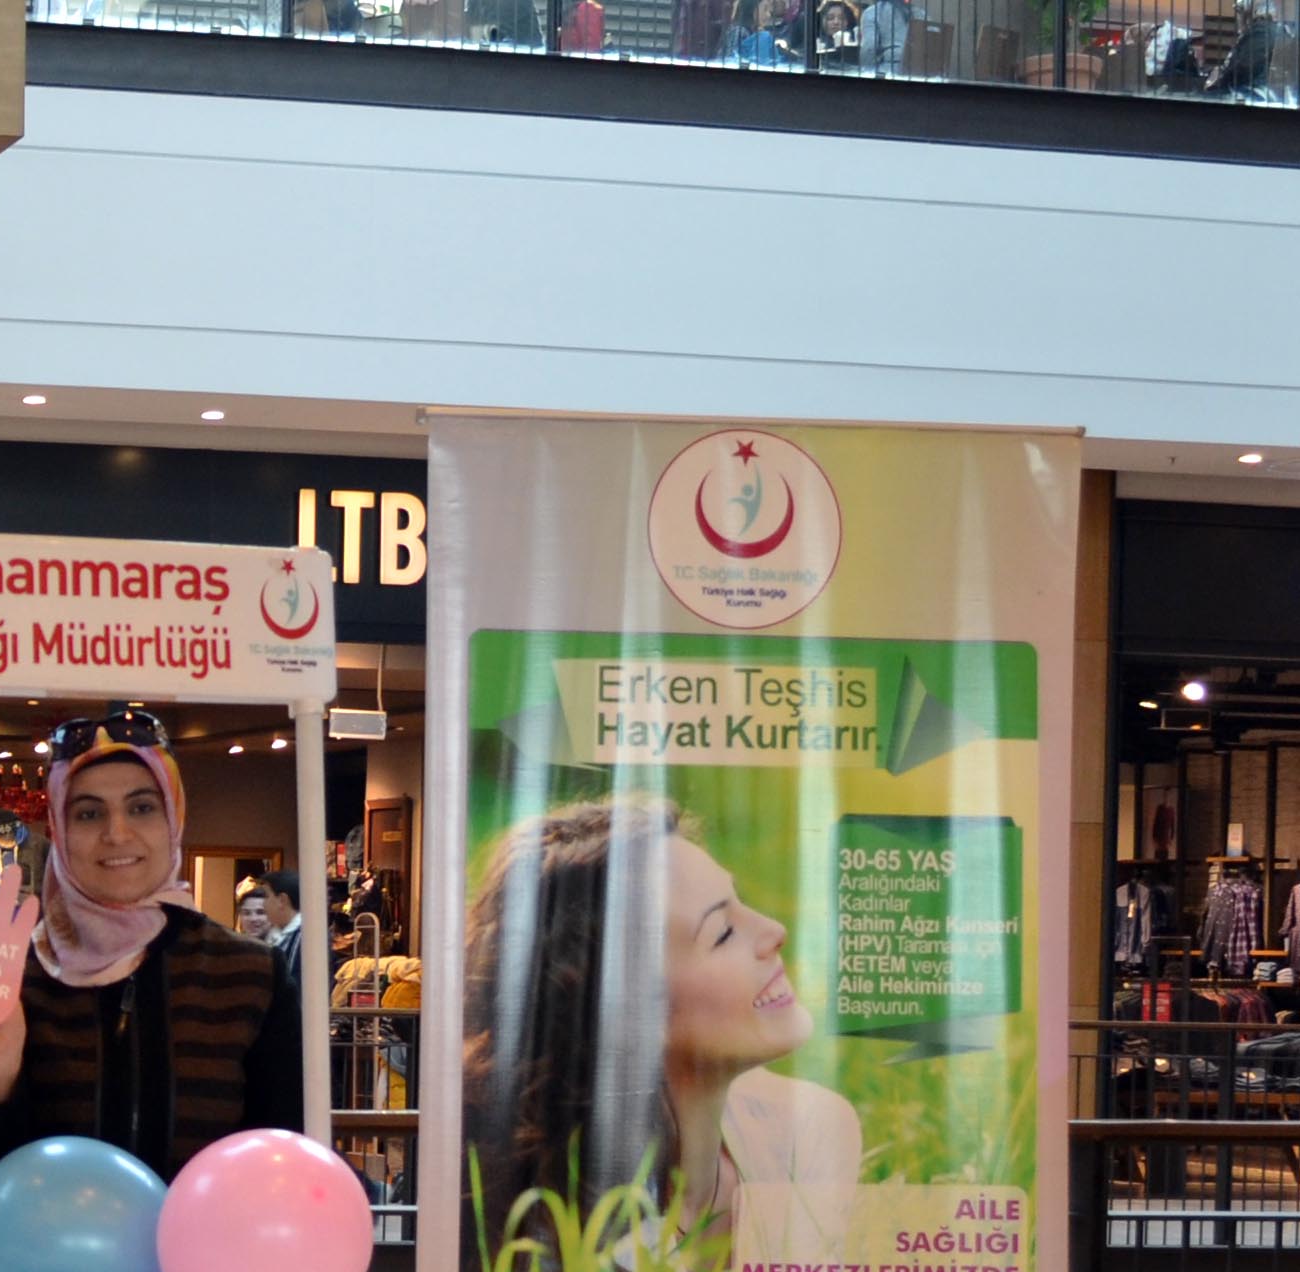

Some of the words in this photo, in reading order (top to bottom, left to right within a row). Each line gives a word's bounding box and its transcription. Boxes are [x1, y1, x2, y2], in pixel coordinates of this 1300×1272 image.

[33, 622, 232, 679] Müdürlüğü
[598, 666, 717, 705] Erken
[734, 668, 867, 718] Teşhis
[598, 713, 711, 755] Hayat
[725, 715, 884, 753] Kurtarır.
[840, 849, 901, 871] 30-65
[907, 849, 957, 877] YAŞ
[838, 874, 941, 895] Aralığındaki
[838, 894, 911, 913] Kadınlar
[838, 914, 896, 933] Rahim
[900, 916, 940, 938] Ağzı
[946, 916, 1019, 934] Kanseri
[838, 935, 892, 955] (HPV)
[838, 955, 907, 974] KETEM
[911, 958, 953, 978] veya
[838, 974, 874, 994] Aile
[880, 975, 985, 996] Hekiminize
[955, 1194, 1021, 1222] AİLE
[895, 1225, 1020, 1255] SAĞLIĞI
